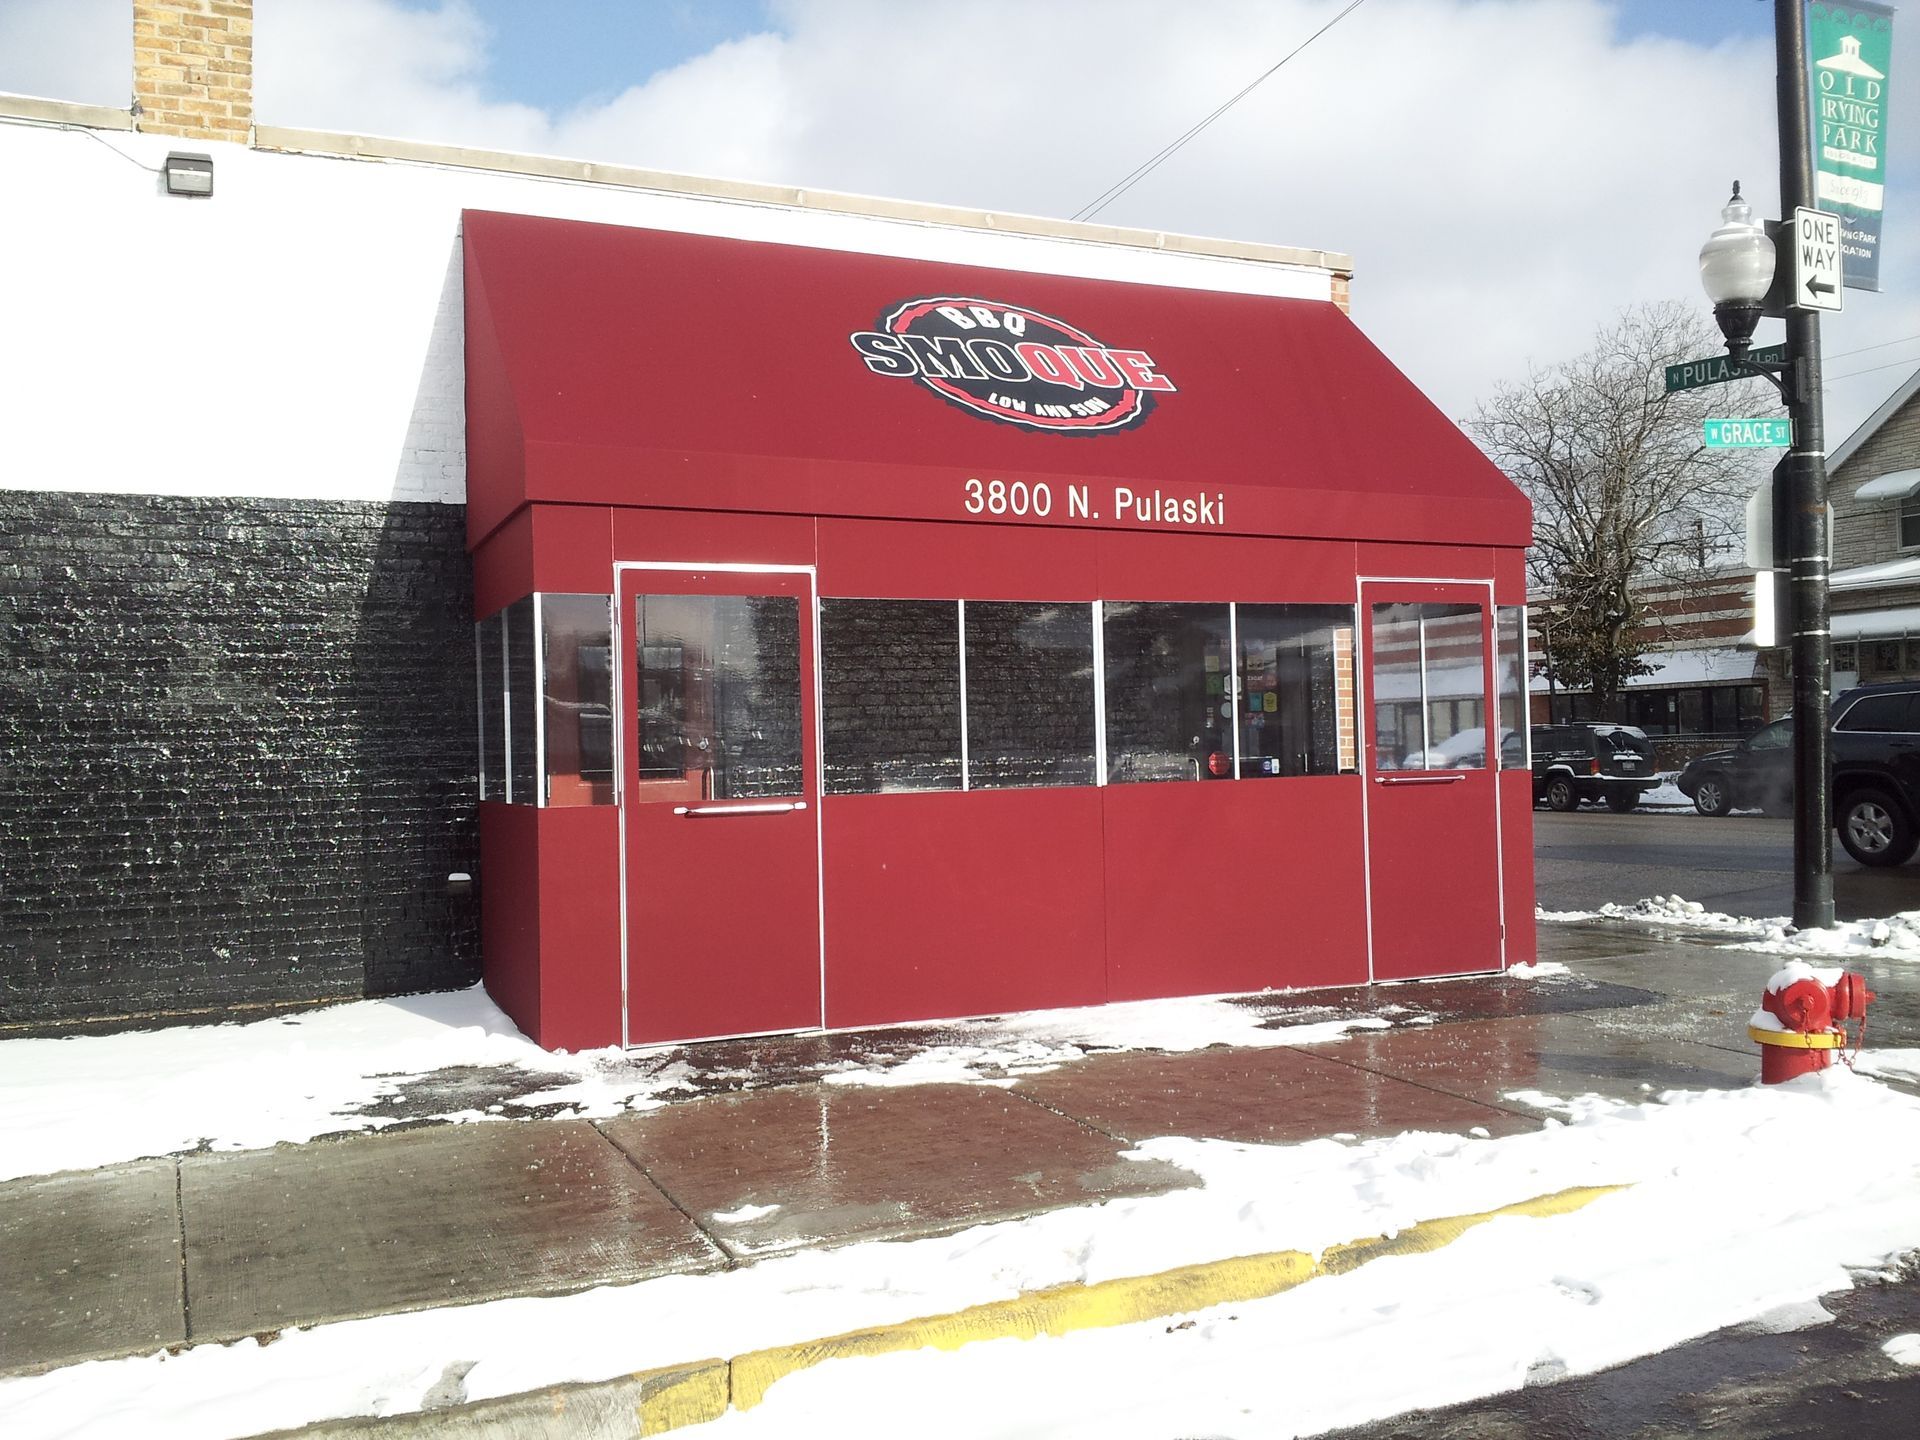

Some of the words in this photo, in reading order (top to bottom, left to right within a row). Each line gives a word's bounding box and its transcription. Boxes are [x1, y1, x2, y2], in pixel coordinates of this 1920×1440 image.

[1822, 97, 1879, 128] IRVING
[1823, 124, 1877, 154] PARK
[1803, 219, 1834, 245] ONE
[1859, 231, 1877, 244] PARK
[1802, 245, 1835, 271] WAY
[936, 306, 1026, 337] BBQ
[850, 332, 1177, 391] SMOQUE
[1673, 372, 1679, 383] N
[1765, 353, 1779, 363] RD
[988, 392, 1027, 412] LOW
[1035, 403, 1073, 418] AND
[1069, 396, 1112, 416] SLOW
[1711, 428, 1718, 440] W
[1721, 423, 1773, 444] GRACE
[1775, 427, 1785, 438] ST
[964, 479, 1052, 517] 3800
[1068, 485, 1099, 519] N.
[1115, 487, 1224, 525] Pulaski
